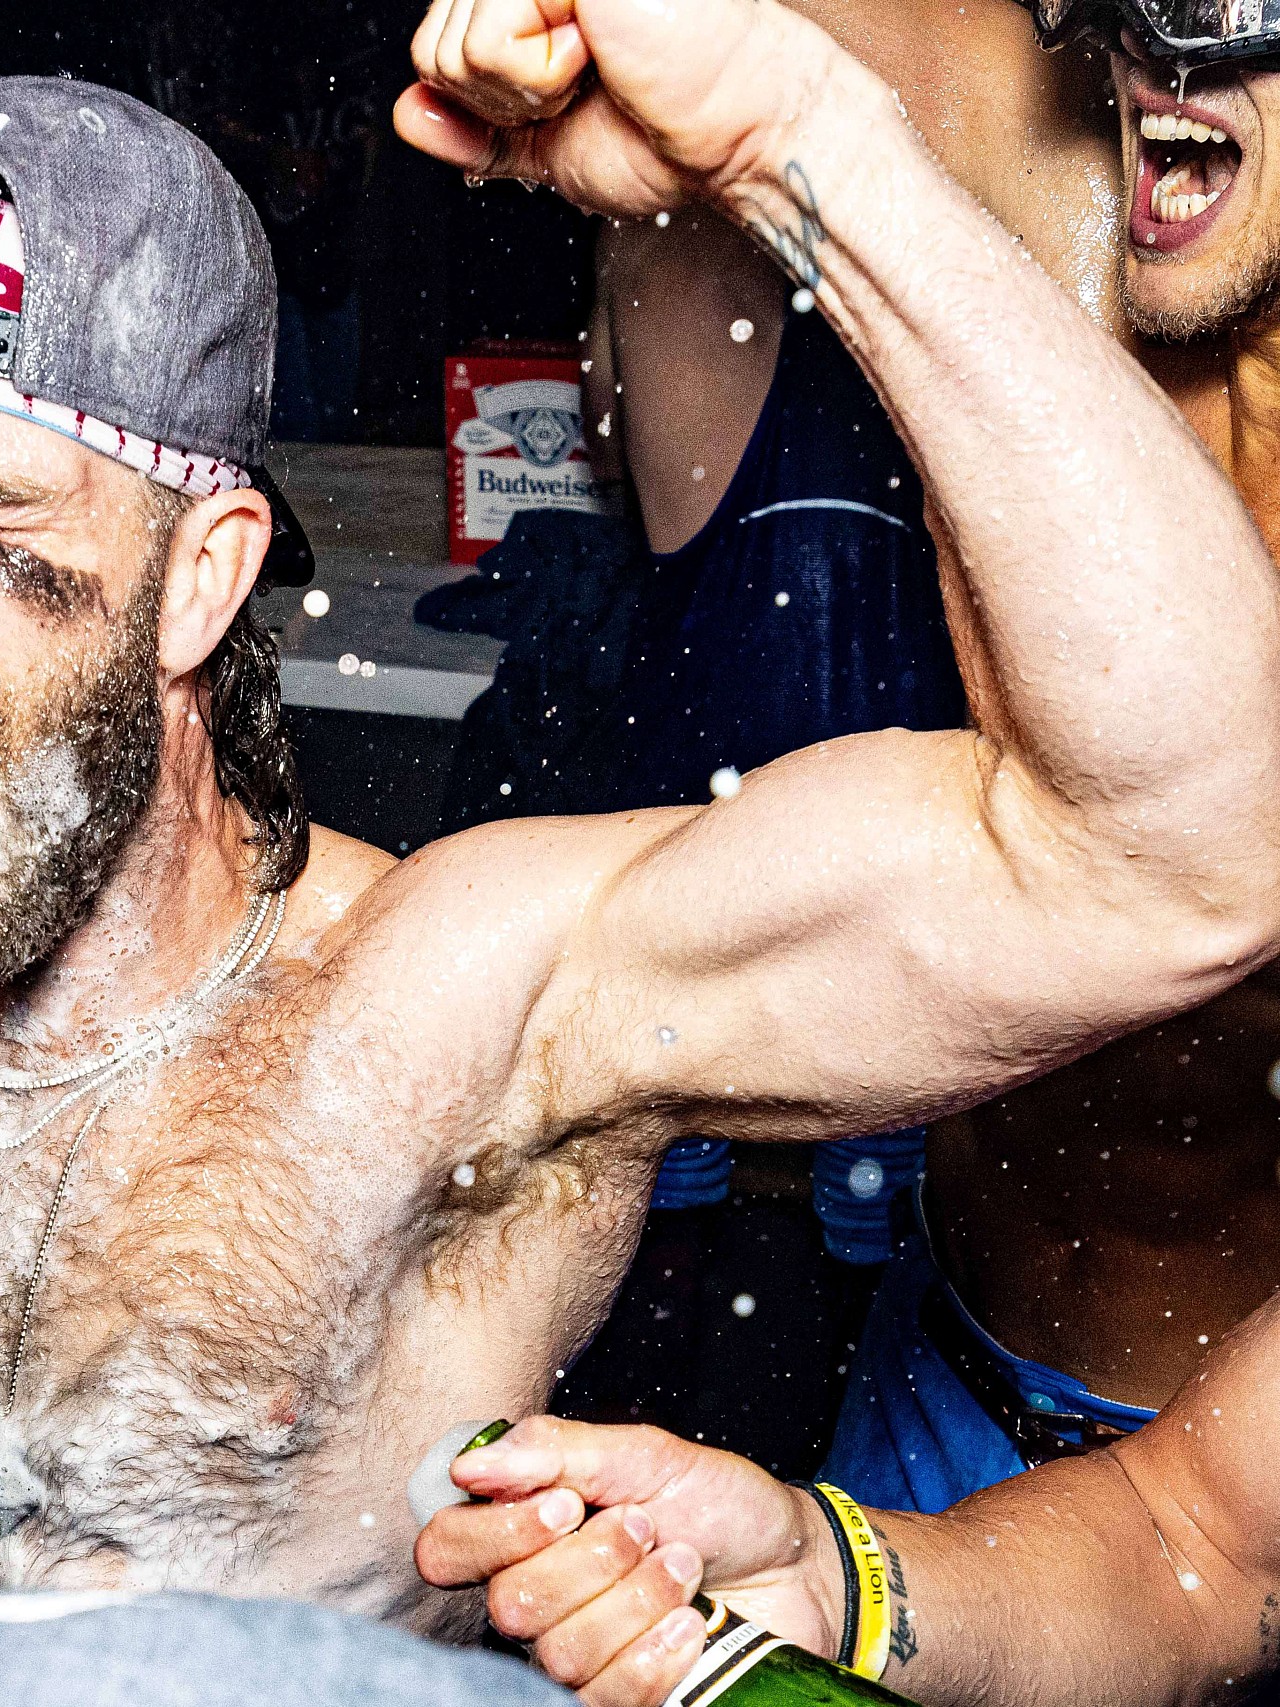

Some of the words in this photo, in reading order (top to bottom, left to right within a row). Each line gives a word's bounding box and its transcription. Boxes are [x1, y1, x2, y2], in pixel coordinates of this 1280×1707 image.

[829, 1490, 864, 1528] Like
[858, 1533, 872, 1546] a
[864, 1552, 885, 1605] Lion
